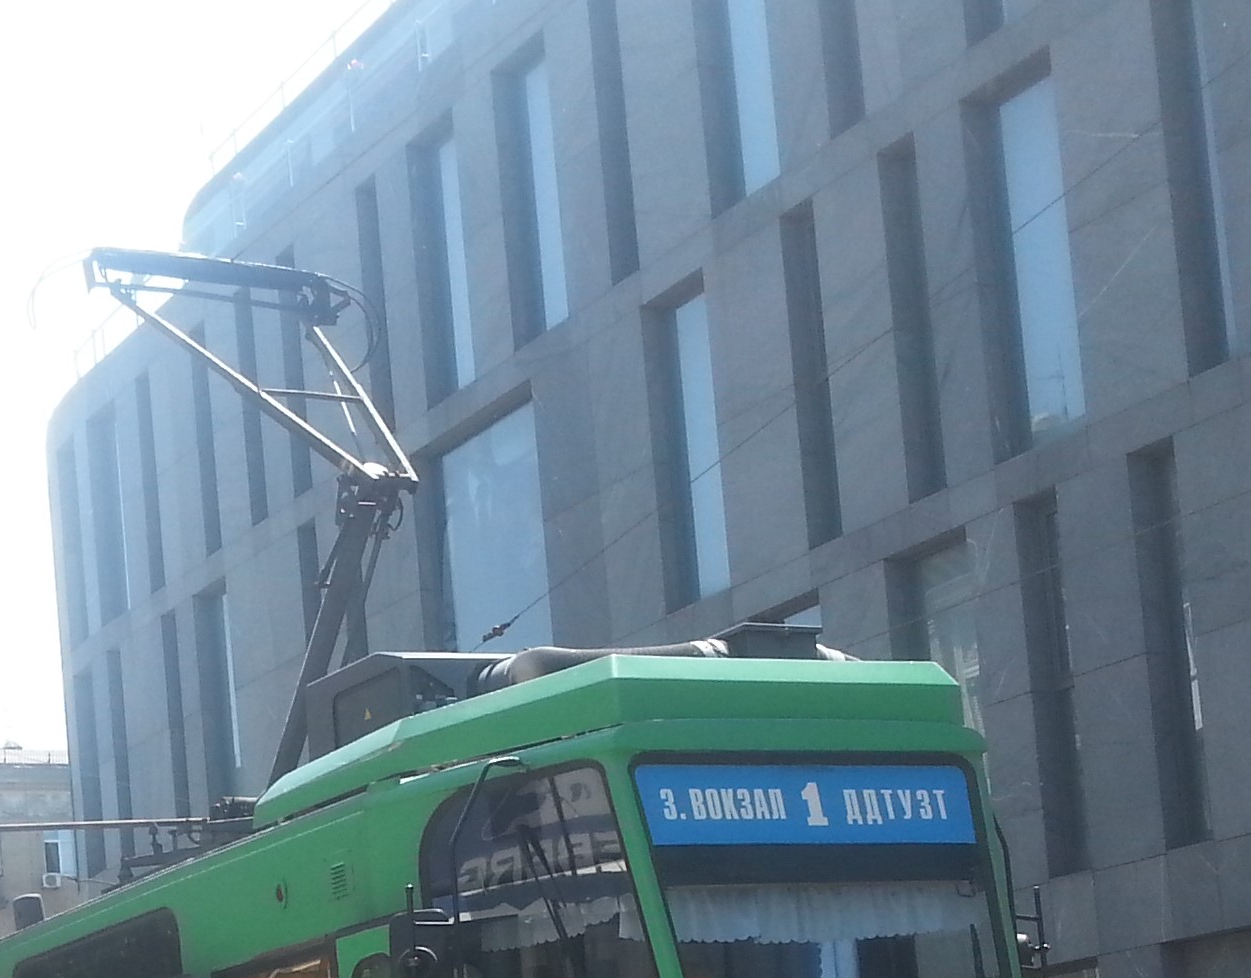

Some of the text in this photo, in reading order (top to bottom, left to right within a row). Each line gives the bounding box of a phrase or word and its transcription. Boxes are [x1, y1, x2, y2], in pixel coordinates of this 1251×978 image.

[690, 787, 787, 821] ВОКЗАЛ
[800, 781, 829, 827] 1
[843, 787, 950, 826] ДДТУЗТ
